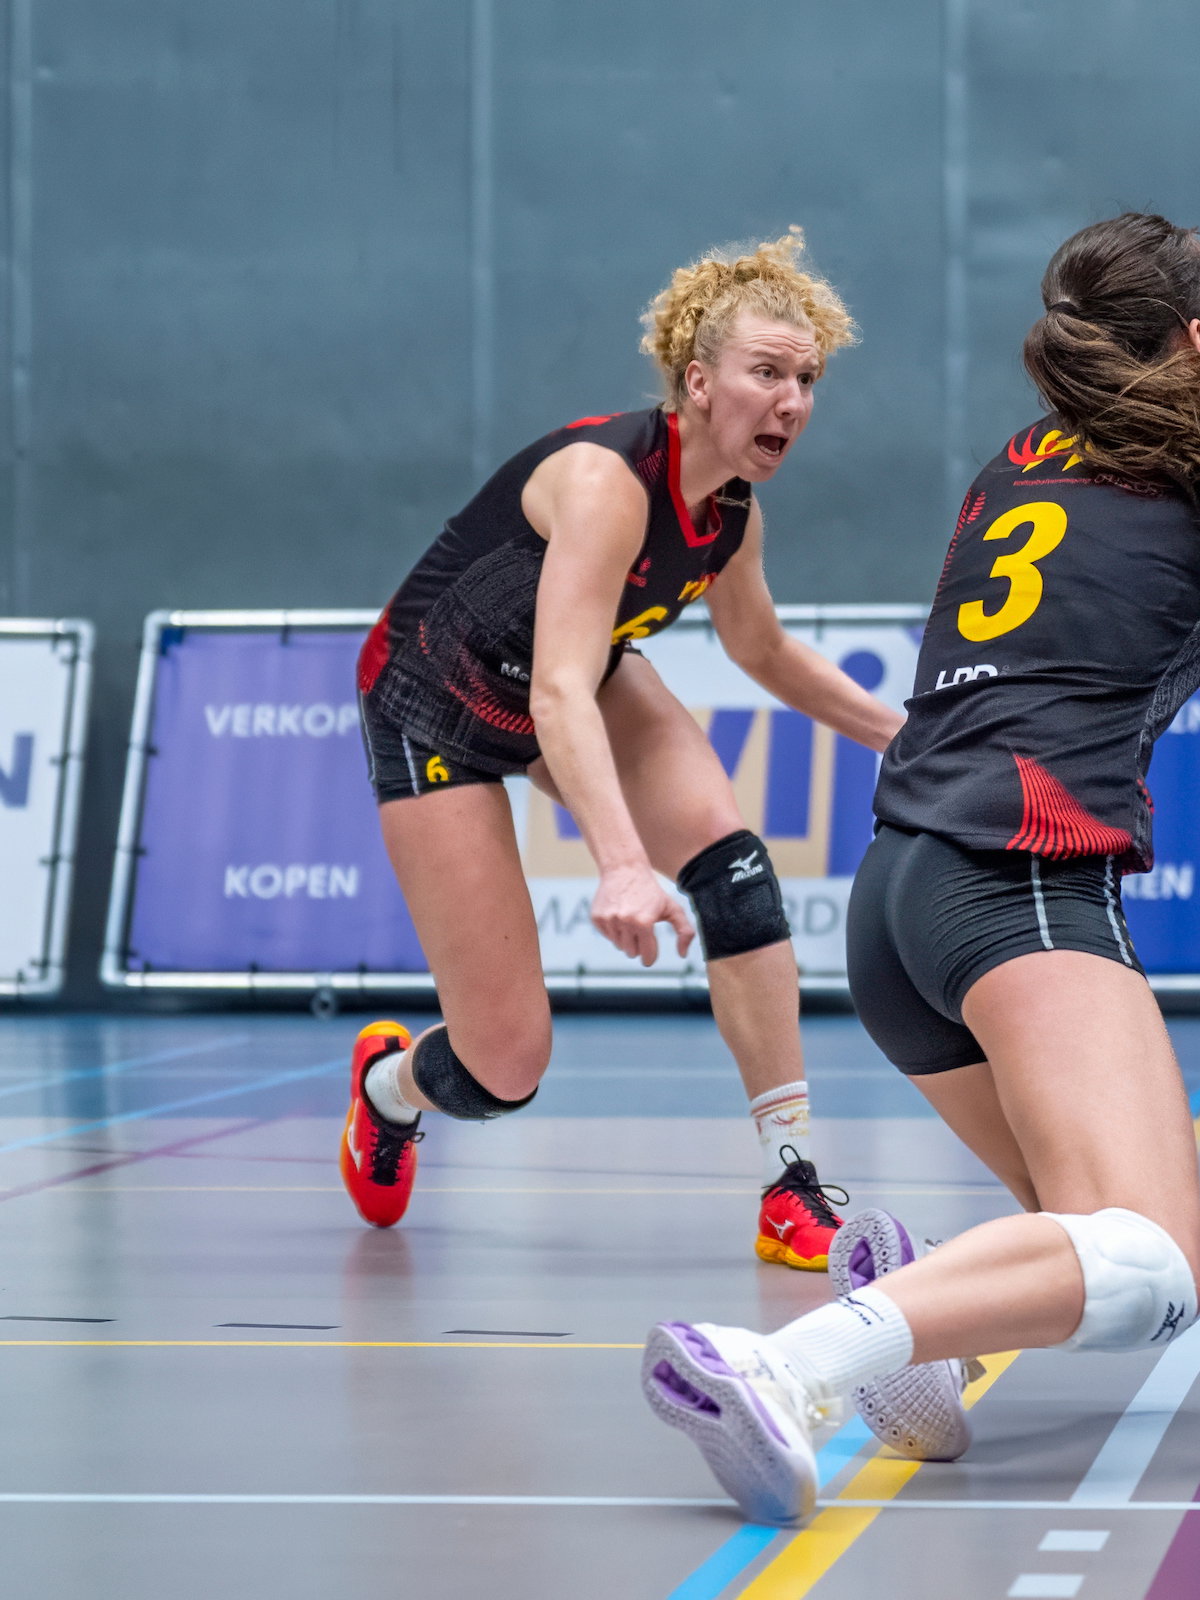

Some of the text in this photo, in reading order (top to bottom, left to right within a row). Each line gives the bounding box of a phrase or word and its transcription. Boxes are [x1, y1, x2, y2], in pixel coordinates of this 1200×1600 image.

[957, 501, 1068, 642] 3
[204, 703, 361, 737] VERKOP
[426, 755, 449, 782] 6
[224, 865, 358, 899] KOPEN
